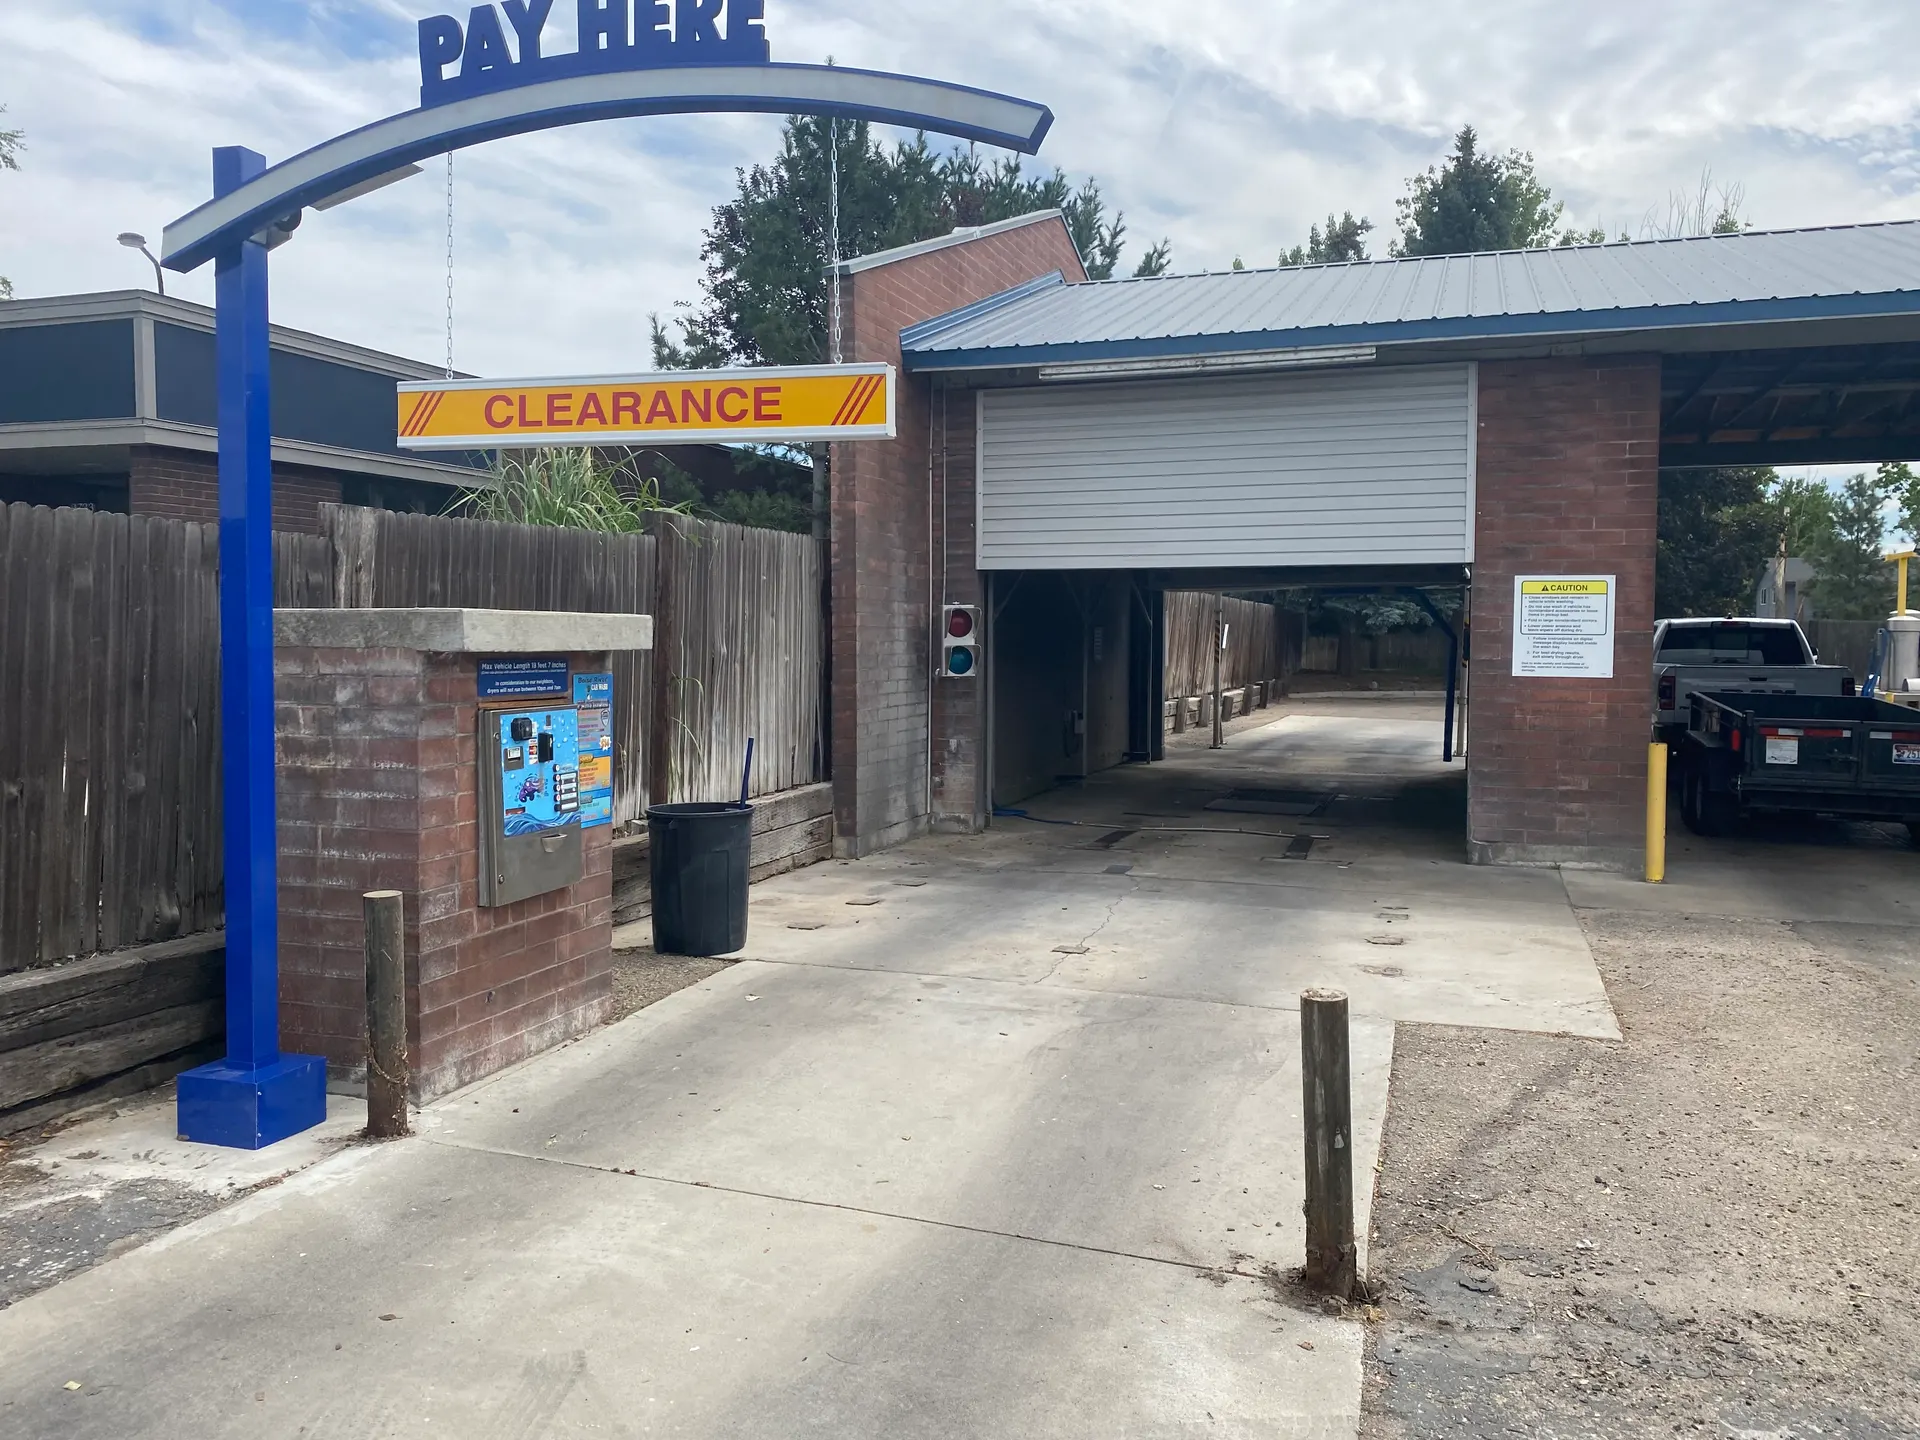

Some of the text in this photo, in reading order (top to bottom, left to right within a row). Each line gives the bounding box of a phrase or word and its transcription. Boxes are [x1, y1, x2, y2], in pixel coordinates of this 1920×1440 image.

[418, 0, 551, 84] PAY
[484, 386, 783, 429] CLEARANCE
[513, 663, 530, 671] Length
